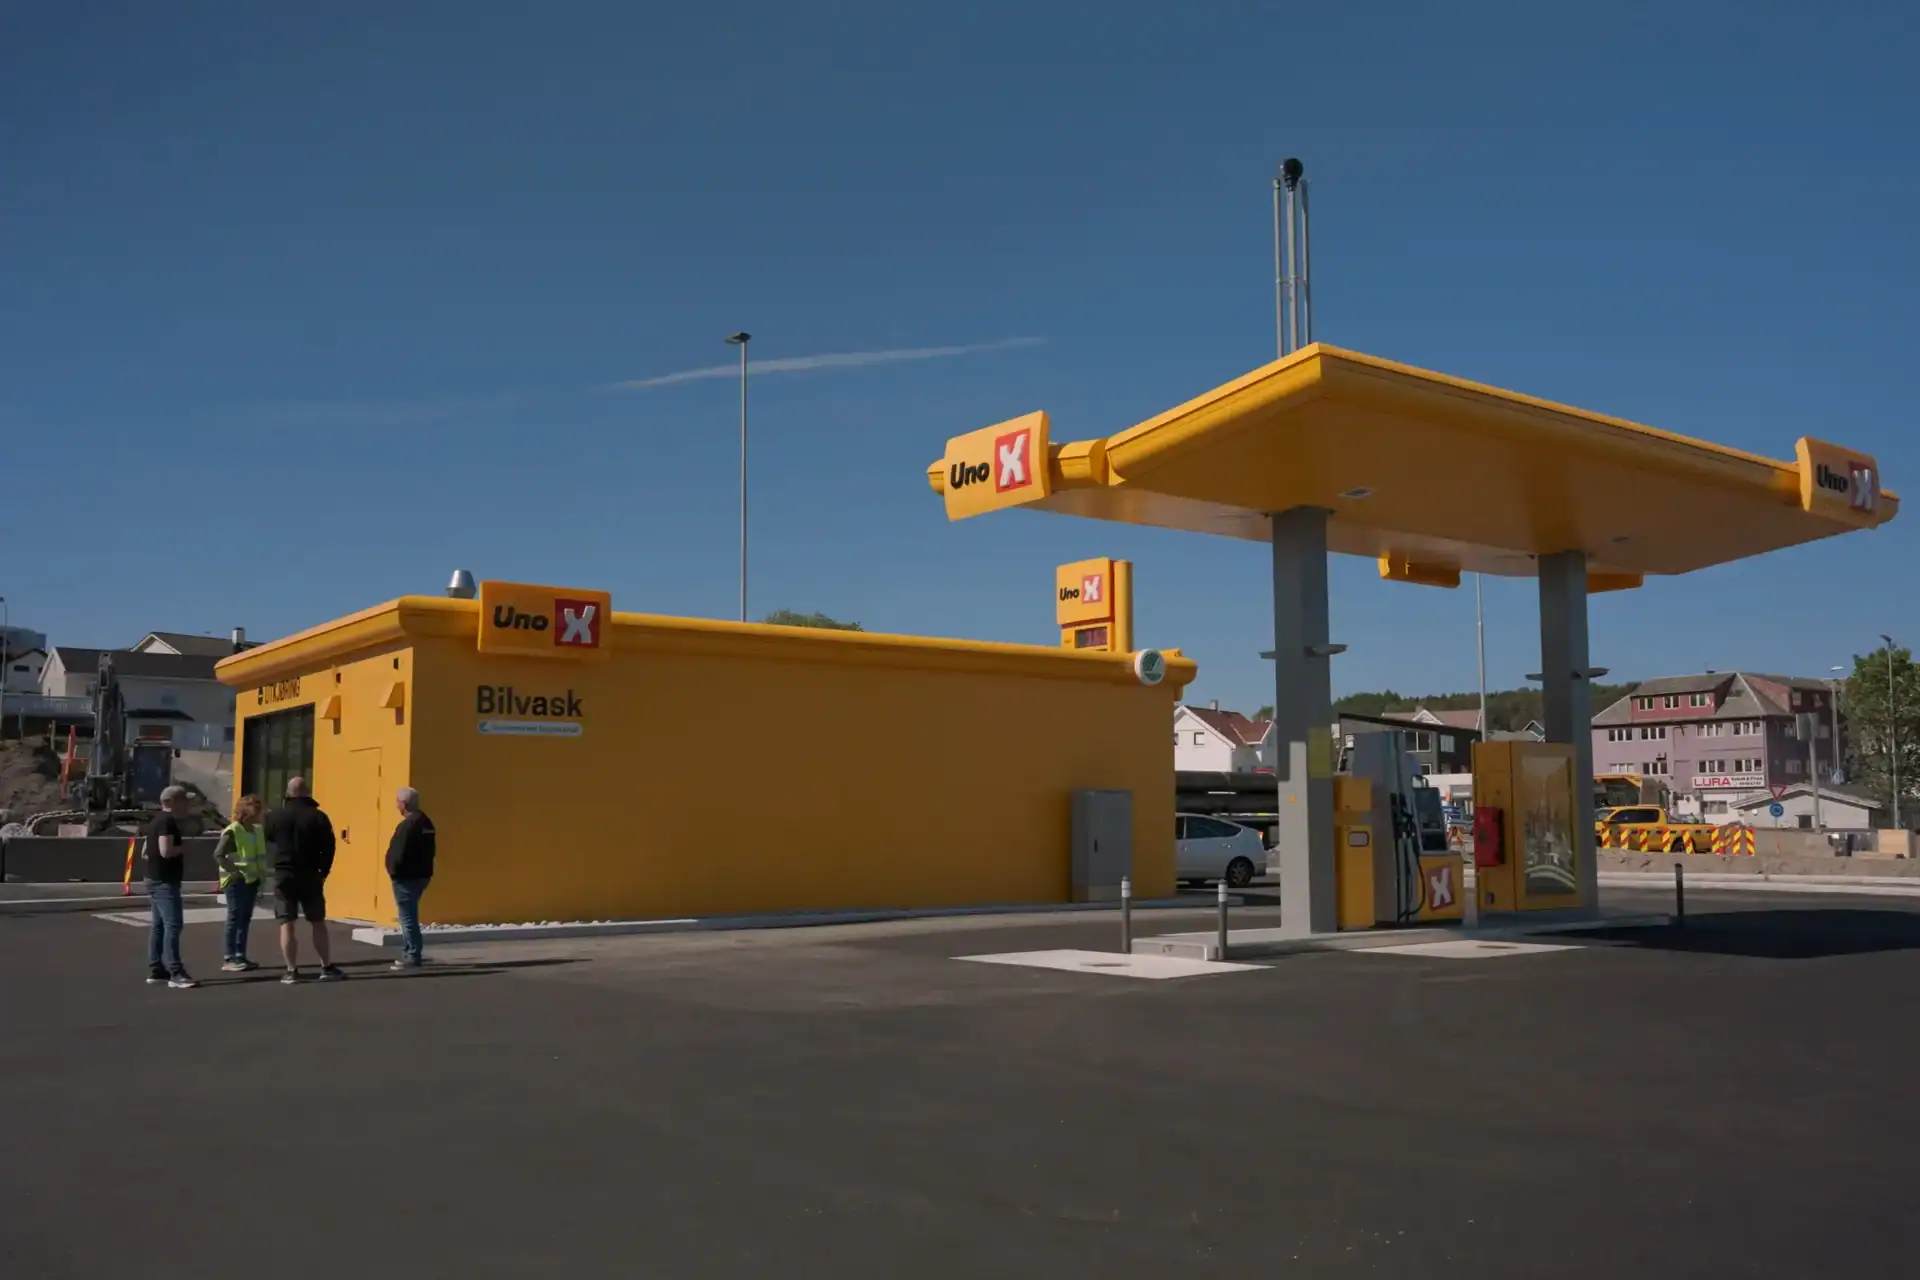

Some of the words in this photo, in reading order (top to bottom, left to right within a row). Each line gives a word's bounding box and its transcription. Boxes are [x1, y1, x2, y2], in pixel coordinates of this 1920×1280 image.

[950, 461, 990, 490] Uno
[999, 433, 1027, 487] X
[1816, 463, 1848, 493] Uno
[1852, 468, 1873, 510] X
[1059, 587, 1080, 601] Uno
[1083, 575, 1101, 602] X
[494, 605, 549, 631] Uno
[561, 605, 596, 644] X
[477, 685, 584, 717] Bilvask
[1694, 777, 1731, 786] LURA
[1431, 867, 1452, 908] X
